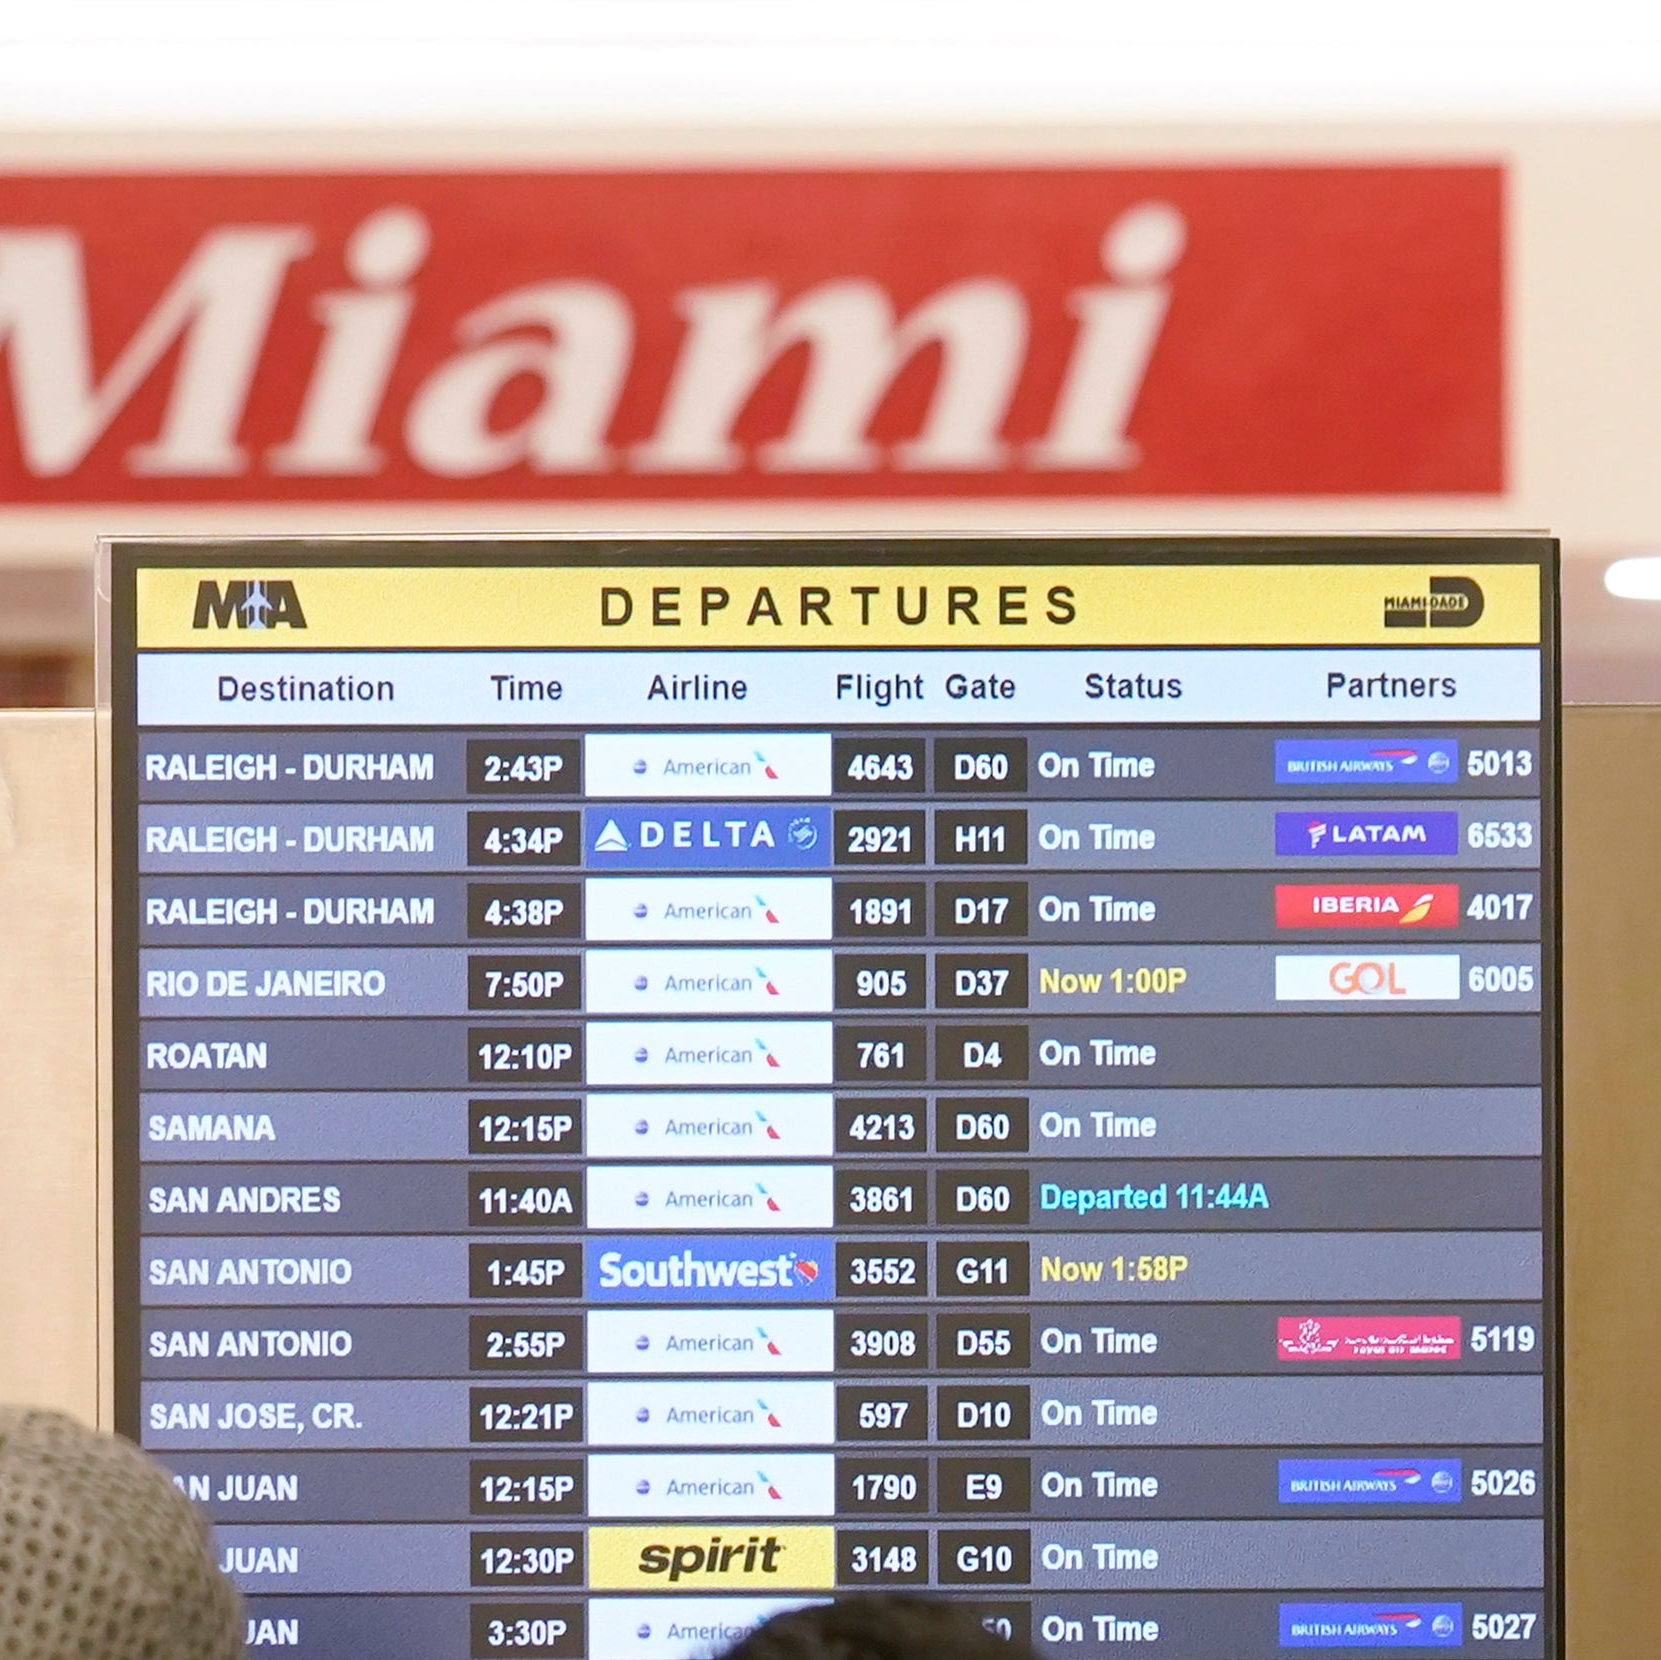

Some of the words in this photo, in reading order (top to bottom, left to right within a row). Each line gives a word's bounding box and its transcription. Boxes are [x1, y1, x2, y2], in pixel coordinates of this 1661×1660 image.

[602, 586, 1078, 627] DEPARTURES
[219, 676, 393, 701] Destination
[491, 675, 562, 700] Time
[648, 675, 747, 700] Airline
[837, 674, 923, 707] Flight
[946, 674, 1015, 699] Gate
[1086, 674, 1182, 698] Status
[1328, 673, 1456, 698] Partners
[848, 755, 913, 780] 4643
[1333, 825, 1426, 842] LATAM
[1314, 896, 1399, 913] IBERIA
[147, 971, 198, 996] RIO
[207, 971, 247, 996] DE
[255, 971, 385, 996] JANEIRO
[486, 972, 563, 997] 7:50P
[1330, 962, 1406, 994] GOL
[1469, 966, 1533, 991] 6005
[148, 1043, 266, 1068] ROATAN
[149, 1115, 275, 1140] SAMANA
[149, 1187, 208, 1213] SAN
[216, 1187, 340, 1212] ANDRES
[480, 1188, 572, 1213] 11:40A
[850, 1187, 911, 1212] 3861
[1041, 1184, 1166, 1215] Departed
[1176, 1183, 1269, 1208] 11:44A
[151, 1403, 209, 1429] SAN
[218, 1403, 304, 1434] JOSE,
[312, 1403, 362, 1428] CR.
[480, 1404, 573, 1429] 12:21P
